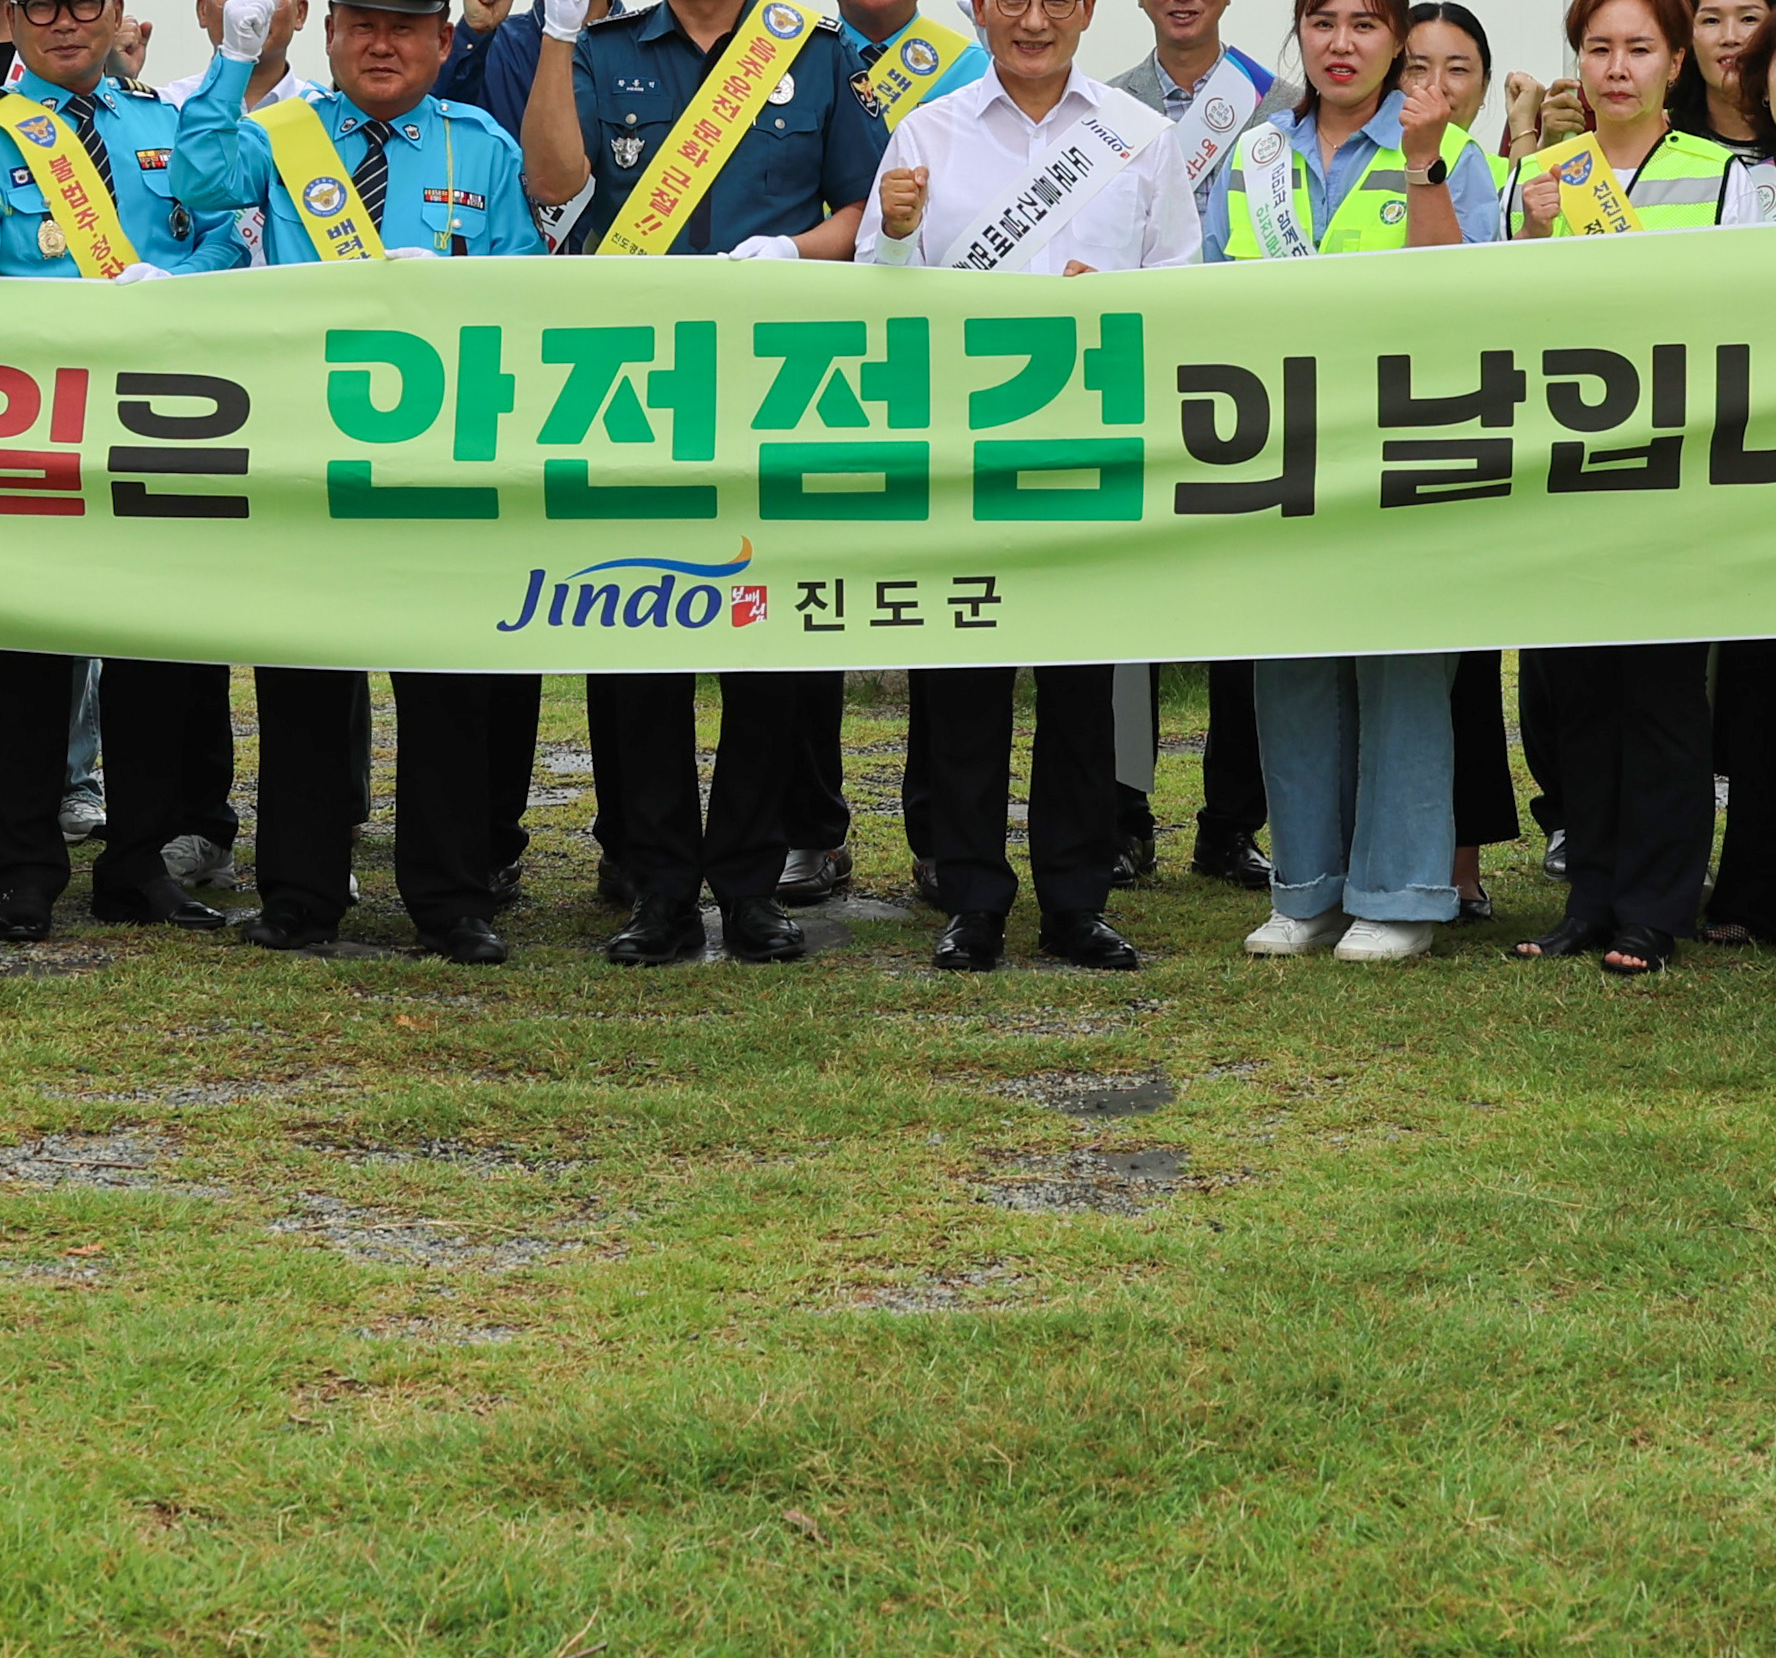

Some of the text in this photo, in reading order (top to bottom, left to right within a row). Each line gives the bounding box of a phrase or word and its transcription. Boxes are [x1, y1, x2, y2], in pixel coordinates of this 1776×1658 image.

[634, 36, 776, 236] 음주운전 문화 근절!!
[1081, 119, 1122, 153] Jindo
[325, 312, 1317, 522] 안전점검의
[496, 568, 723, 632] Jindo
[795, 575, 1002, 632] 진도군
